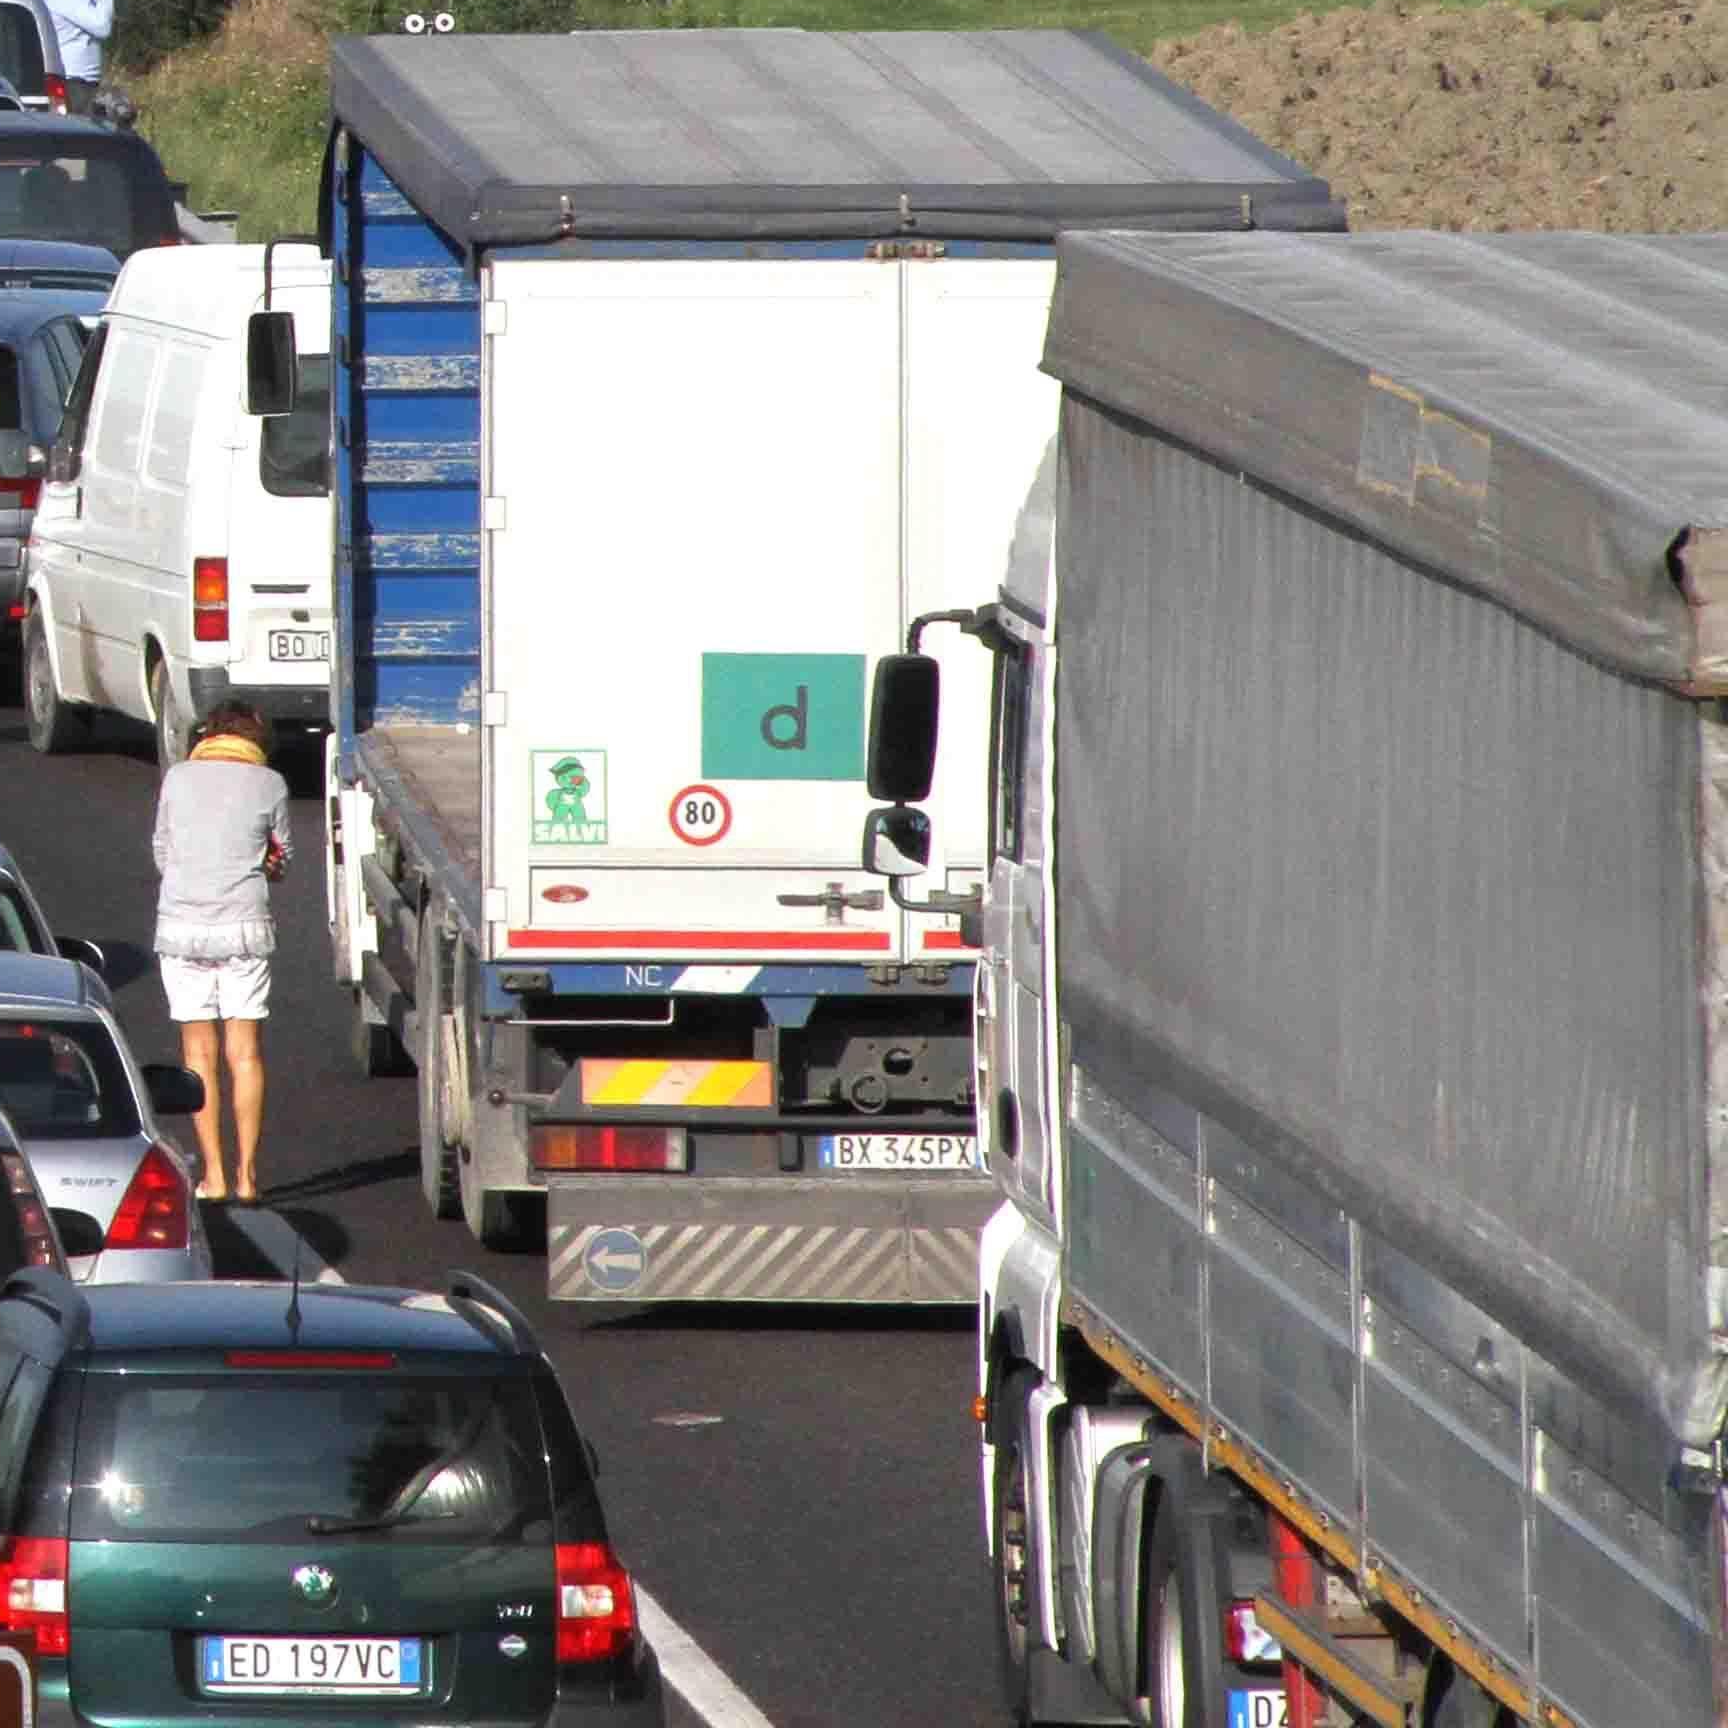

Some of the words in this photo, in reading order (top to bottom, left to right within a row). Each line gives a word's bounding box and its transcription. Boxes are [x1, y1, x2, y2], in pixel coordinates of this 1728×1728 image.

[760, 684, 808, 751] d
[685, 800, 716, 825] 80
[534, 822, 606, 843] SALVI
[625, 964, 663, 986] NC
[839, 1136, 872, 1165] BX
[883, 1136, 971, 1165] 345PX
[60, 1176, 120, 1187] SWIFT
[229, 1643, 271, 1679] ED
[290, 1643, 396, 1679] 197VC
